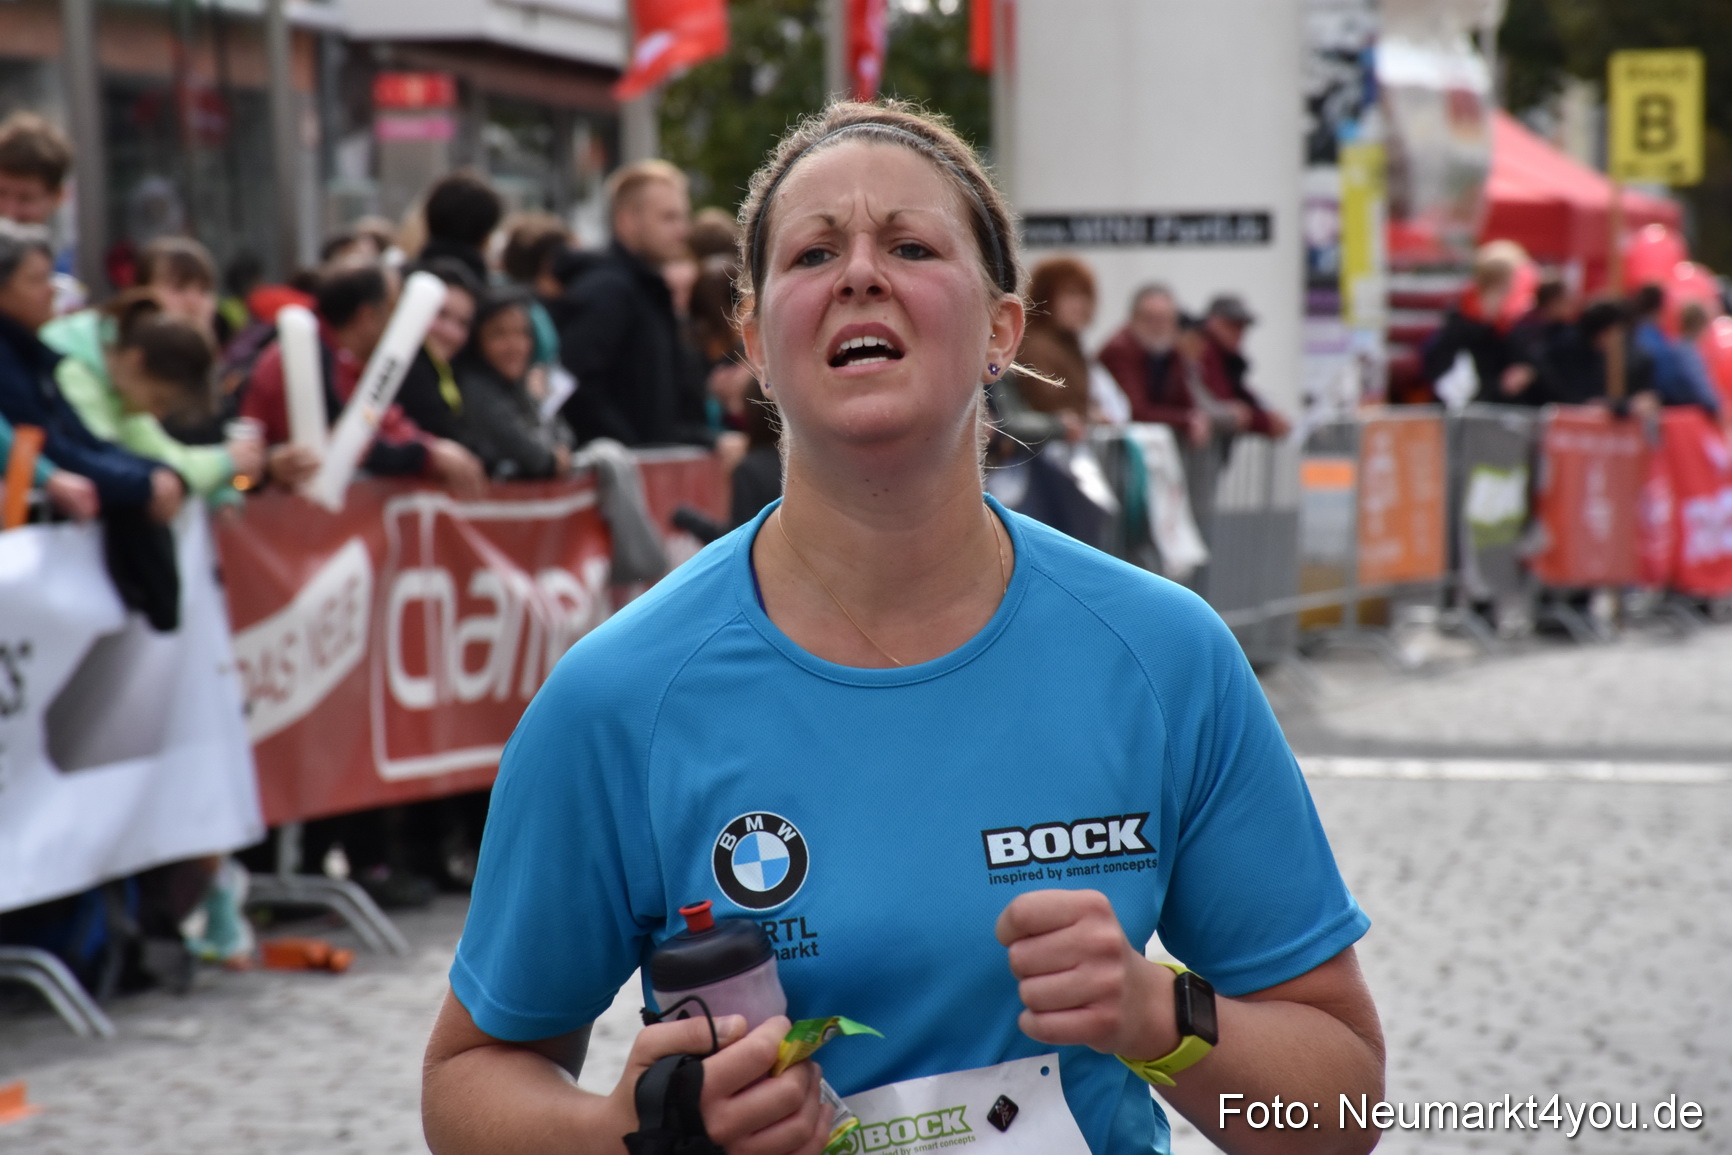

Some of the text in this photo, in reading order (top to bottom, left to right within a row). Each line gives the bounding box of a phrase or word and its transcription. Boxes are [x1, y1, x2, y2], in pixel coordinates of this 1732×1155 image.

[1635, 93, 1676, 153] B
[719, 815, 797, 851] BMW
[984, 815, 1151, 867] BOCK
[989, 858, 1158, 885] inspired by smart concepts
[761, 916, 818, 944] RTL
[861, 1106, 970, 1151] BOCK
[914, 1142, 938, 1153] smart
[940, 1135, 976, 1149] concepts
